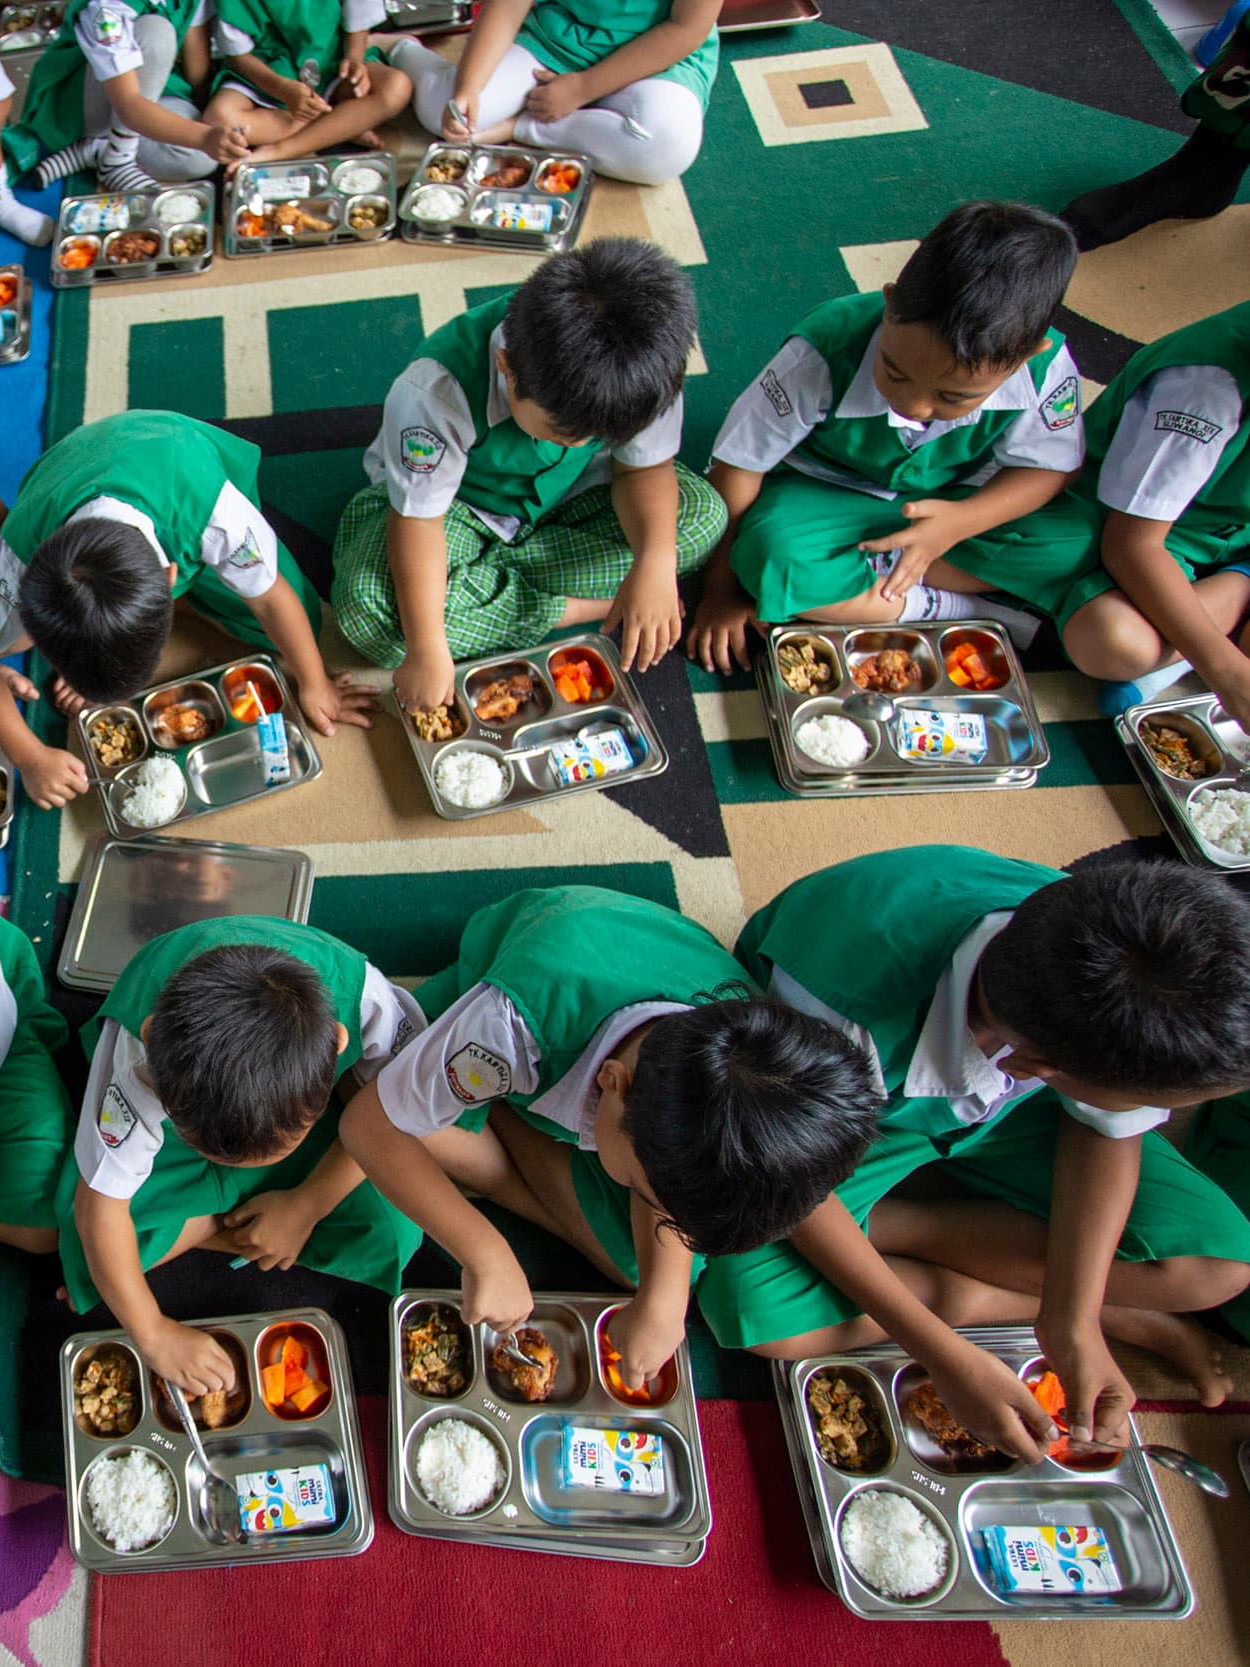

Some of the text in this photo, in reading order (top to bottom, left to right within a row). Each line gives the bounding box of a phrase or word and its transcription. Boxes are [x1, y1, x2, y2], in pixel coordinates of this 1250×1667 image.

[578, 1440, 588, 1468] mimi
[587, 1442, 598, 1469] KIDS
[298, 1479, 311, 1507] KIDS
[308, 1478, 320, 1505] mimi
[1012, 1540, 1030, 1572] mimi
[1024, 1540, 1041, 1572] KIDS
